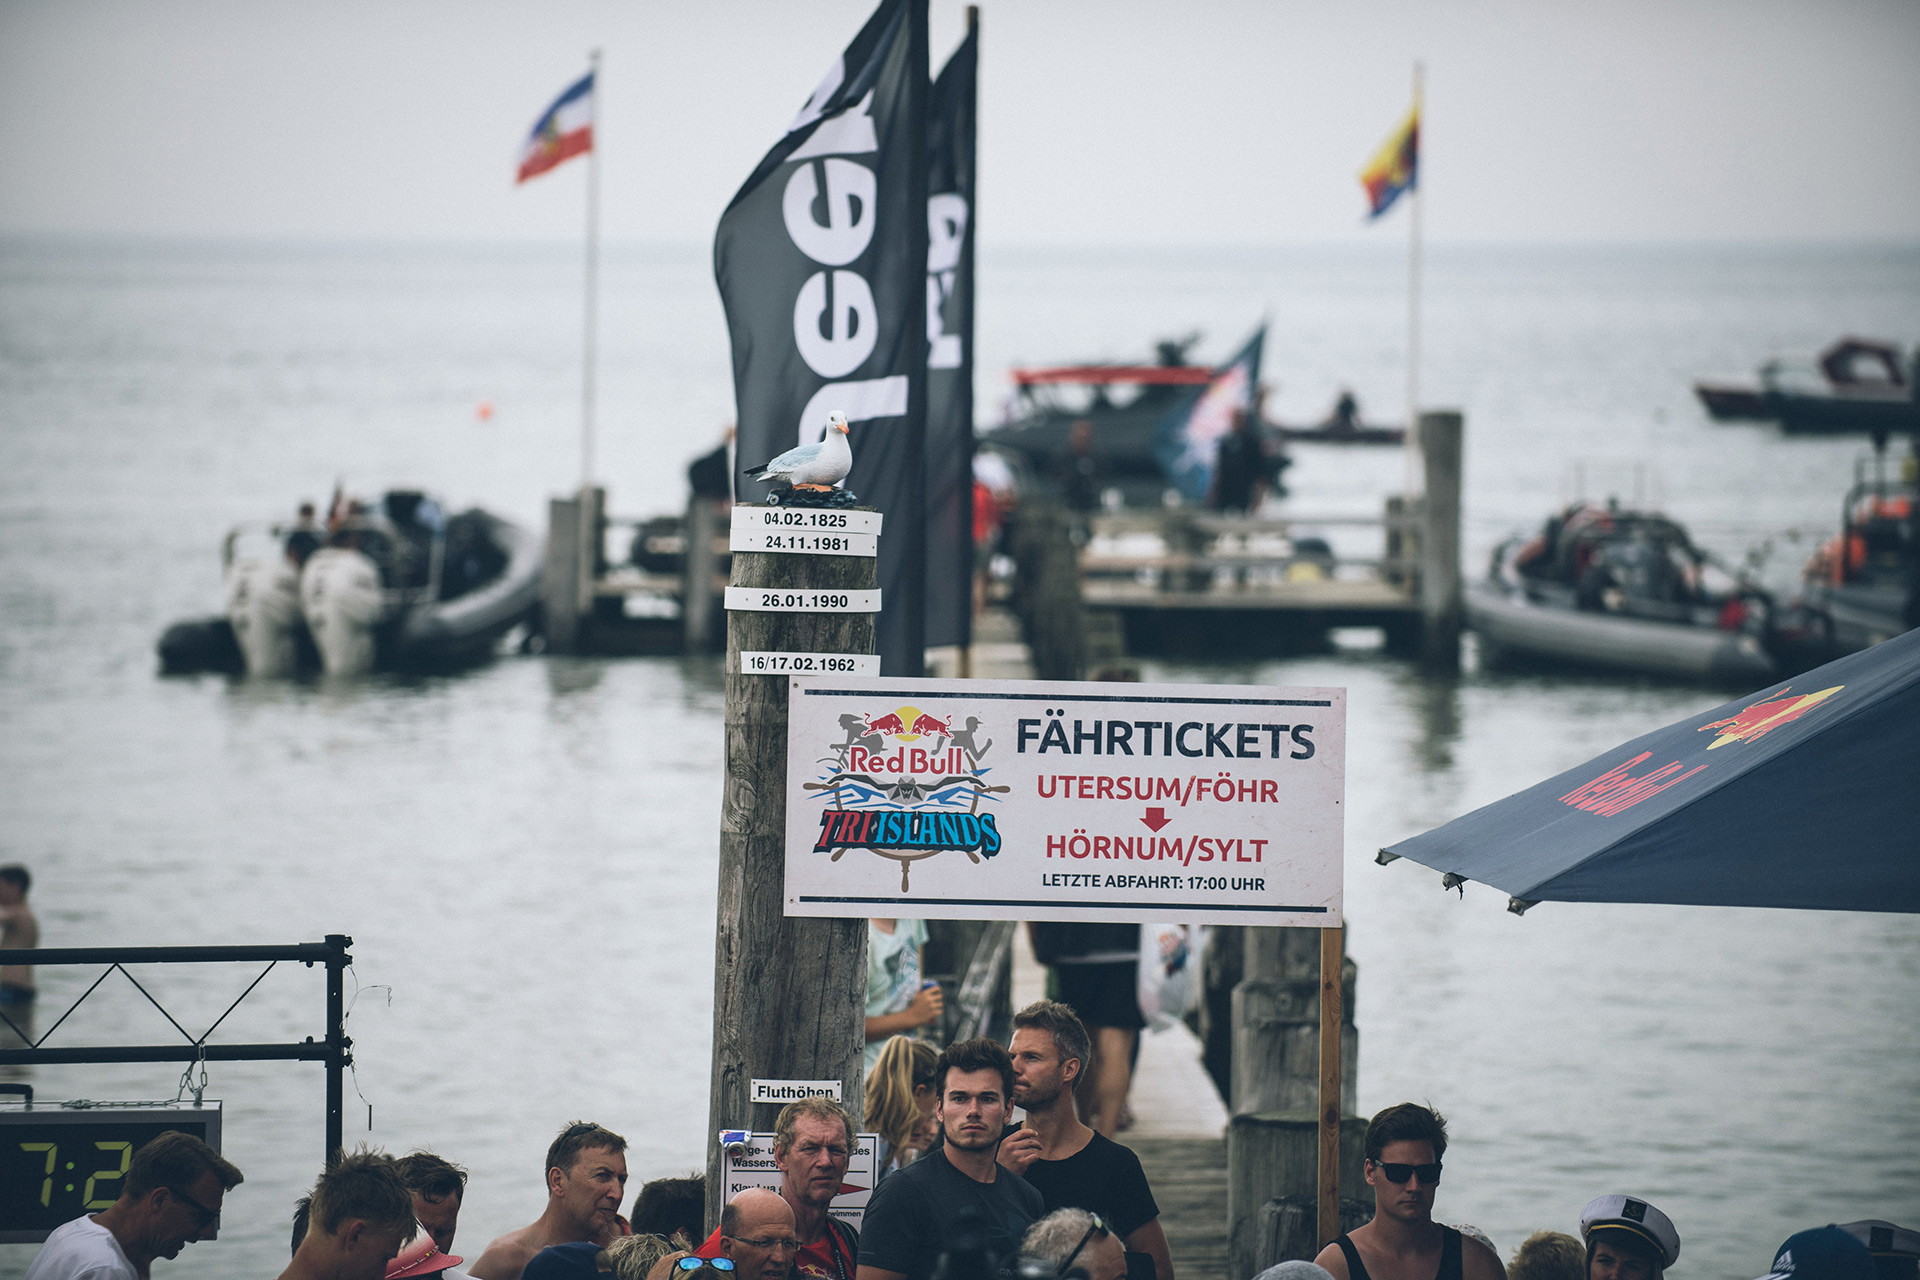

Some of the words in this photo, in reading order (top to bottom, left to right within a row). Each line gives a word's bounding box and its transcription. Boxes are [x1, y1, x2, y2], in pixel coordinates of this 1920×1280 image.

[764, 512, 847, 528] 04.02.1825
[765, 535, 849, 551] 24.11.1981
[762, 594, 848, 608] 26.01.1990
[750, 656, 855, 672] 16/17.02.1962
[1017, 708, 1316, 760] FÄHRTICKETS
[850, 746, 904, 773] Red
[910, 747, 962, 774] Bull
[1037, 772, 1279, 806] UTERSUM/FÖHR
[1046, 828, 1268, 866] HÖRNUM/SYLT
[1042, 873, 1101, 887] LETZTE
[1104, 874, 1183, 889] ABFAHRT:
[1187, 877, 1228, 890] 17:00
[1230, 877, 1265, 891] UHR
[758, 1085, 833, 1099] Fluthöhen
[731, 1158, 778, 1169] Wassers
[19, 1142, 133, 1209] 7:2
